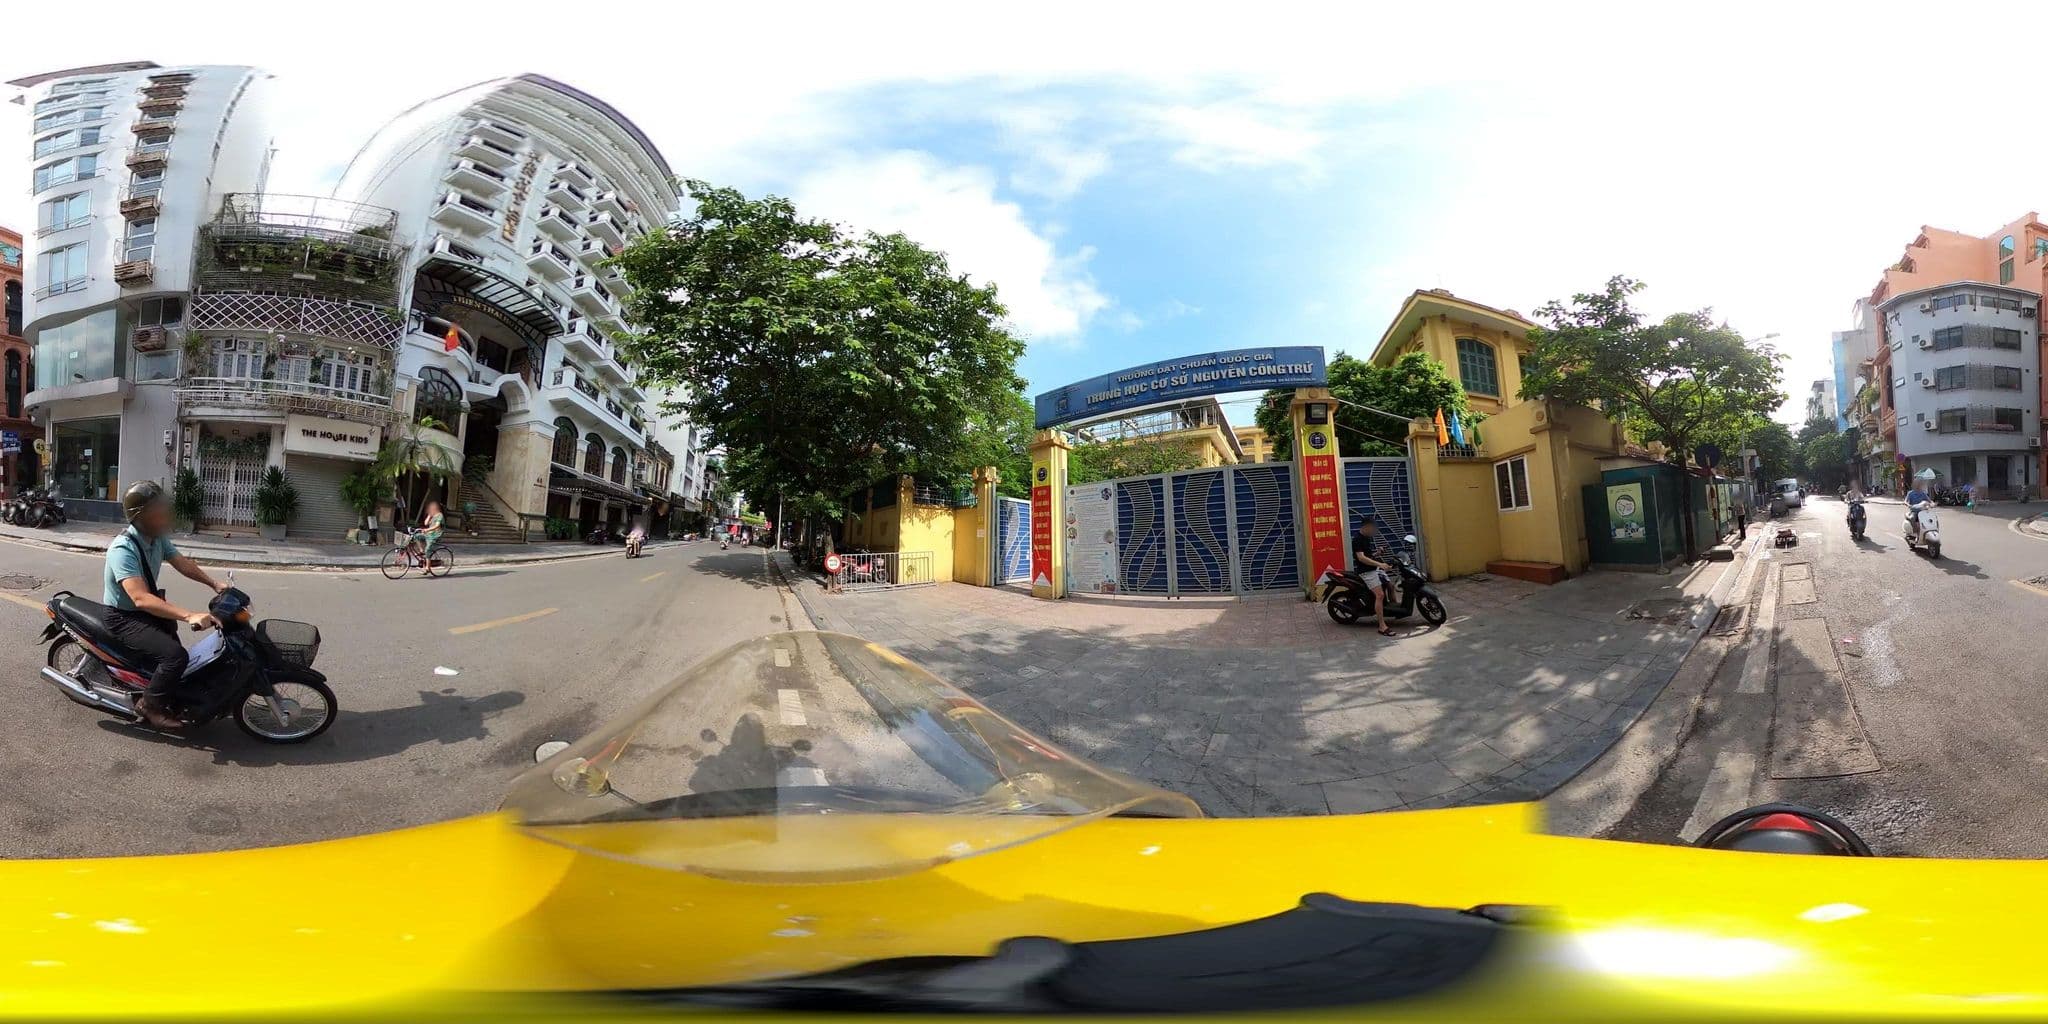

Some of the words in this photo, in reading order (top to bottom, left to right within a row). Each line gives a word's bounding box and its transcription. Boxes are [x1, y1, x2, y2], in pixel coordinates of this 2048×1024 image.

[1254, 353, 1274, 361] GIA
[1087, 389, 1122, 405] TRUNG
[1124, 382, 1149, 397] HỌC
[1151, 377, 1169, 390] CƠ
[1171, 371, 1189, 387] SỞ
[1192, 364, 1247, 383] NGUYỄN
[301, 428, 317, 438] THE
[319, 431, 347, 442] HOUSE
[349, 435, 369, 444] KIDS
